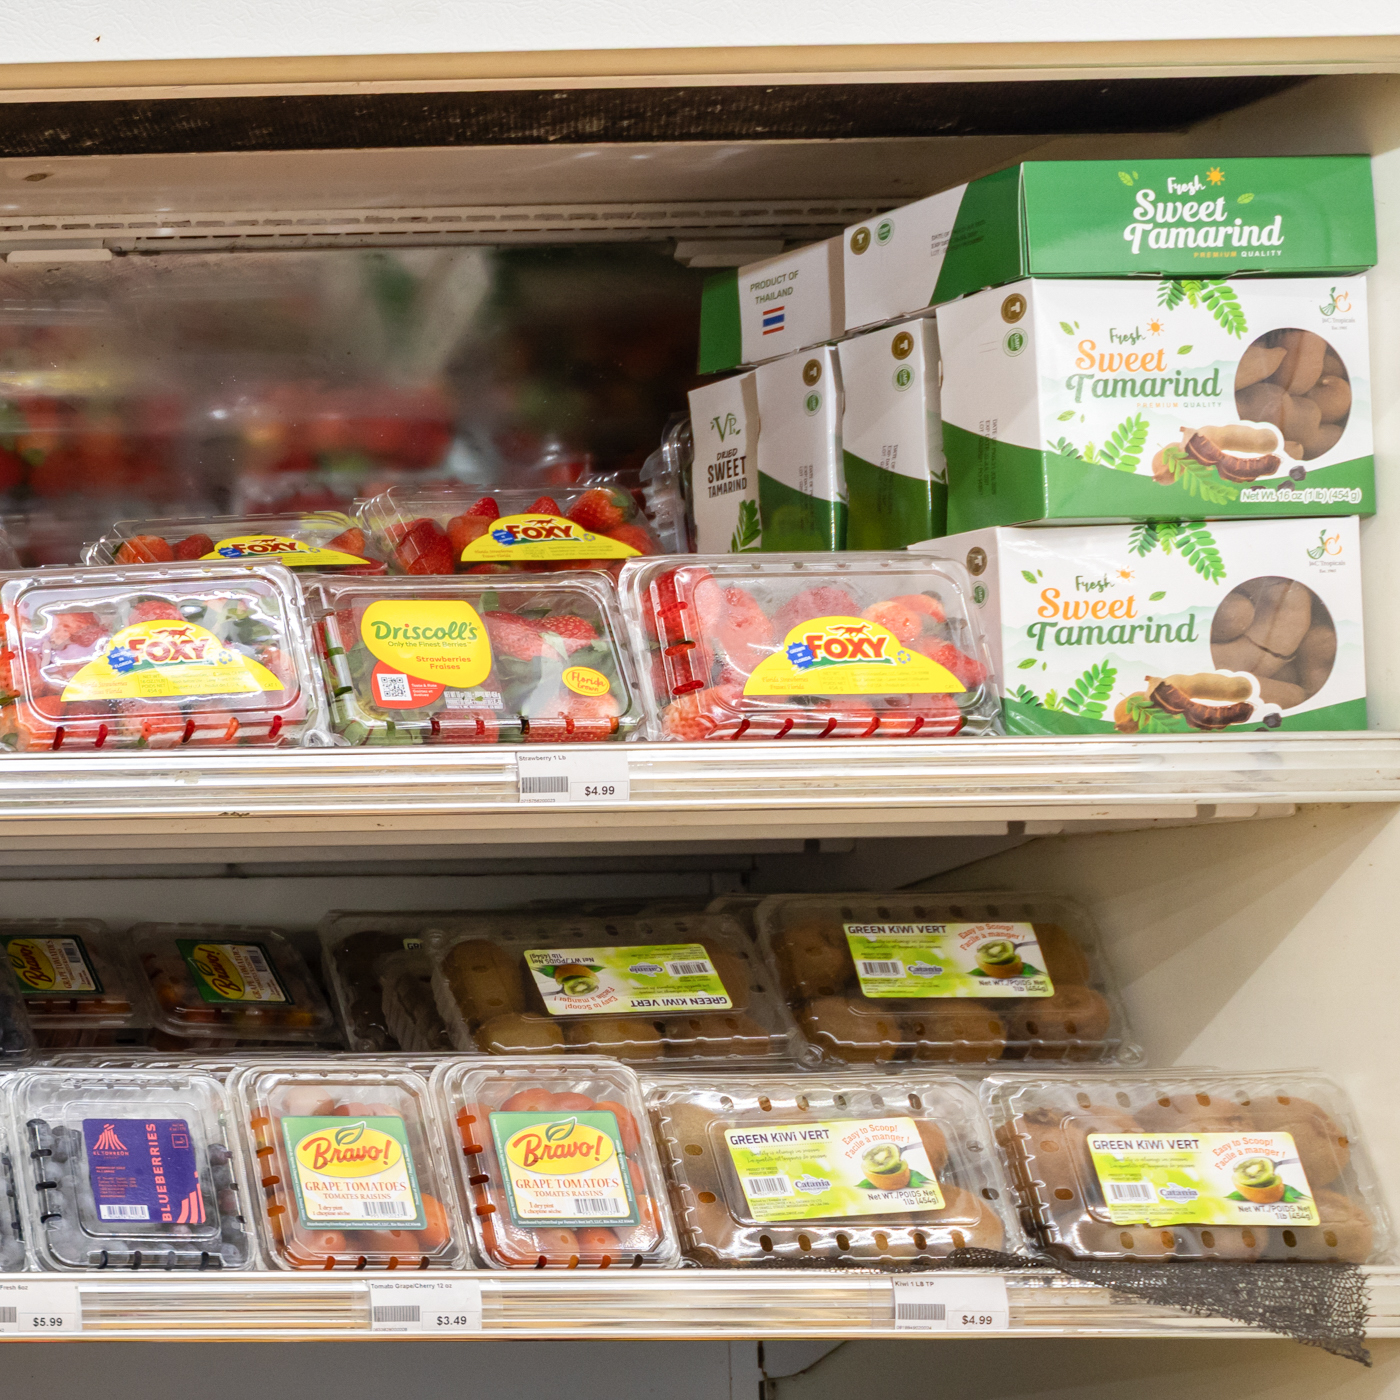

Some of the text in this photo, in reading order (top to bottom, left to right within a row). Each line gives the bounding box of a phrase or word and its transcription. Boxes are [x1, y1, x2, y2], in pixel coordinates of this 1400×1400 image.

[1167, 175, 1206, 195] Fresh
[1133, 189, 1227, 223] Sweet
[1123, 215, 1284, 255] Tamarind
[1241, 250, 1282, 258] QUALITY
[750, 269, 799, 292] PRODUCT OF
[755, 286, 793, 303] THAILAND
[1109, 326, 1146, 346] Fresh
[1075, 339, 1167, 372] Sweet
[1065, 368, 1223, 403] Tamarind
[717, 448, 738, 460] DRIED
[707, 456, 747, 483] SWEET
[708, 477, 747, 498] TAMARIND
[507, 523, 574, 541] FOXY
[235, 541, 298, 555] FOXY
[1075, 575, 1115, 592] Fresh
[1037, 587, 1138, 620] Sweet
[371, 620, 478, 641] Driscoll's
[1026, 614, 1199, 651] Tamarind
[128, 638, 209, 663] FOXY
[388, 641, 405, 649] Only
[804, 635, 888, 660] FOXY
[571, 671, 606, 688] Florida
[584, 786, 615, 796] $4.99
[848, 925, 886, 934] GREEN
[917, 925, 947, 933] VERT
[730, 1133, 768, 1146] GREEN
[799, 1129, 830, 1140] VERT
[842, 1124, 898, 1146] Easy to Scoop!
[302, 1137, 392, 1170] Bravo!
[512, 1133, 603, 1168] Bravo!
[1093, 1140, 1134, 1150] GREEN
[1169, 1139, 1199, 1149] VERT
[146, 1123, 173, 1221] BLUEBERRIES
[305, 1181, 407, 1192] GRAPE TOMATOES
[515, 1178, 619, 1189] GRAPE TOMATOES
[794, 1178, 831, 1190] Catania
[1160, 1188, 1198, 1197] Catania
[33, 1317, 63, 1327] $5.99
[436, 1316, 467, 1326] $3.49
[962, 1315, 992, 1325] $4.99
